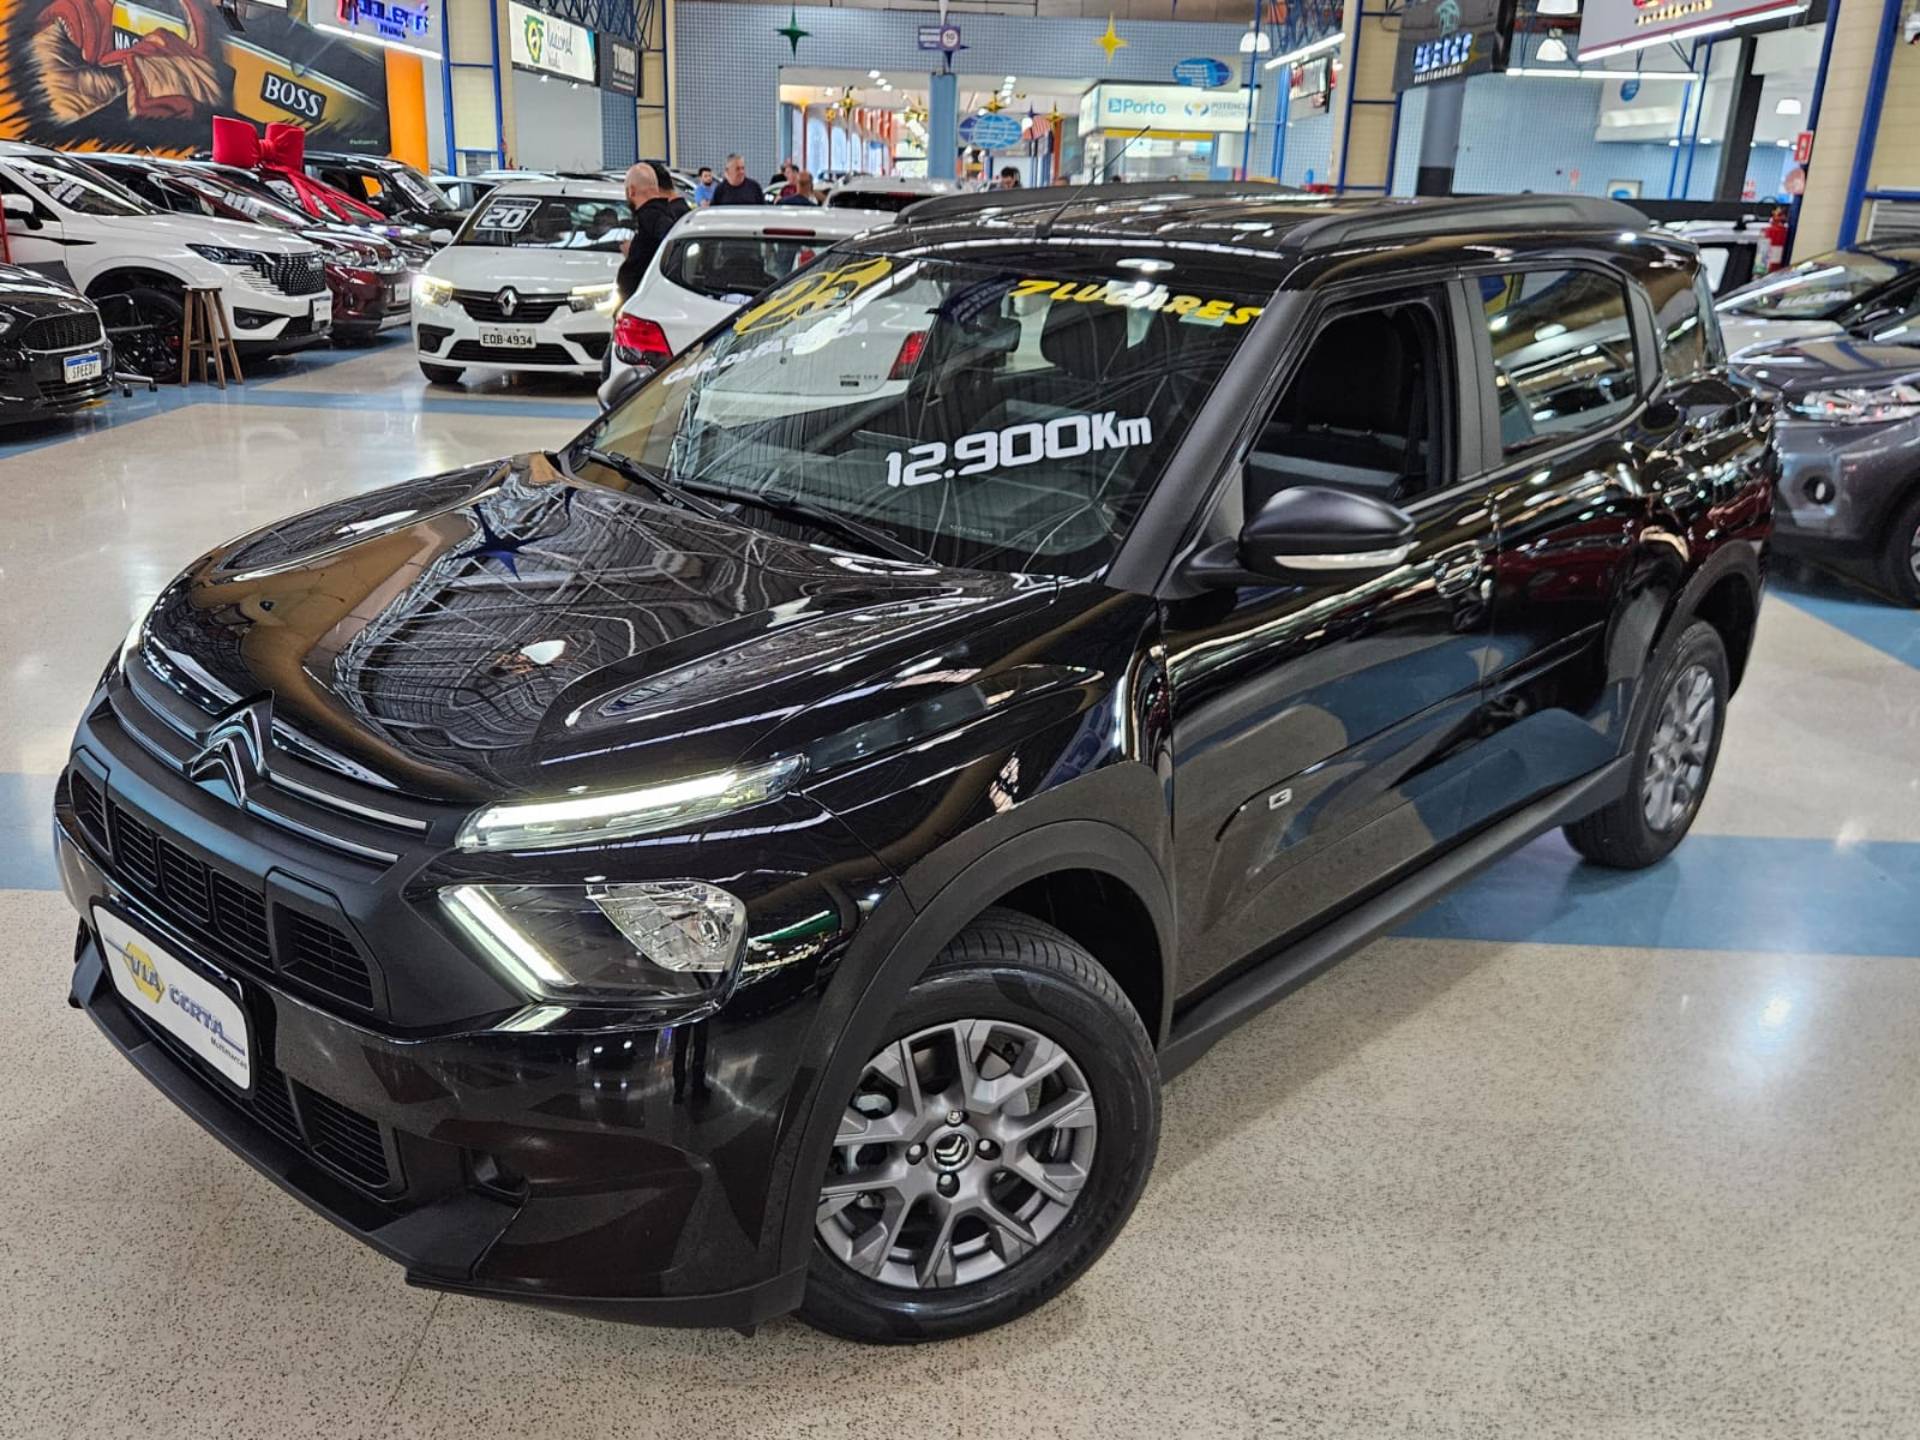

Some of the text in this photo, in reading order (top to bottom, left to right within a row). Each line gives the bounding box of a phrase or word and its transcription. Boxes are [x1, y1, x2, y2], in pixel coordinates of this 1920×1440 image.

[265, 75, 322, 117] BOSS
[1123, 98, 1167, 115] Porto
[481, 208, 527, 228] 20
